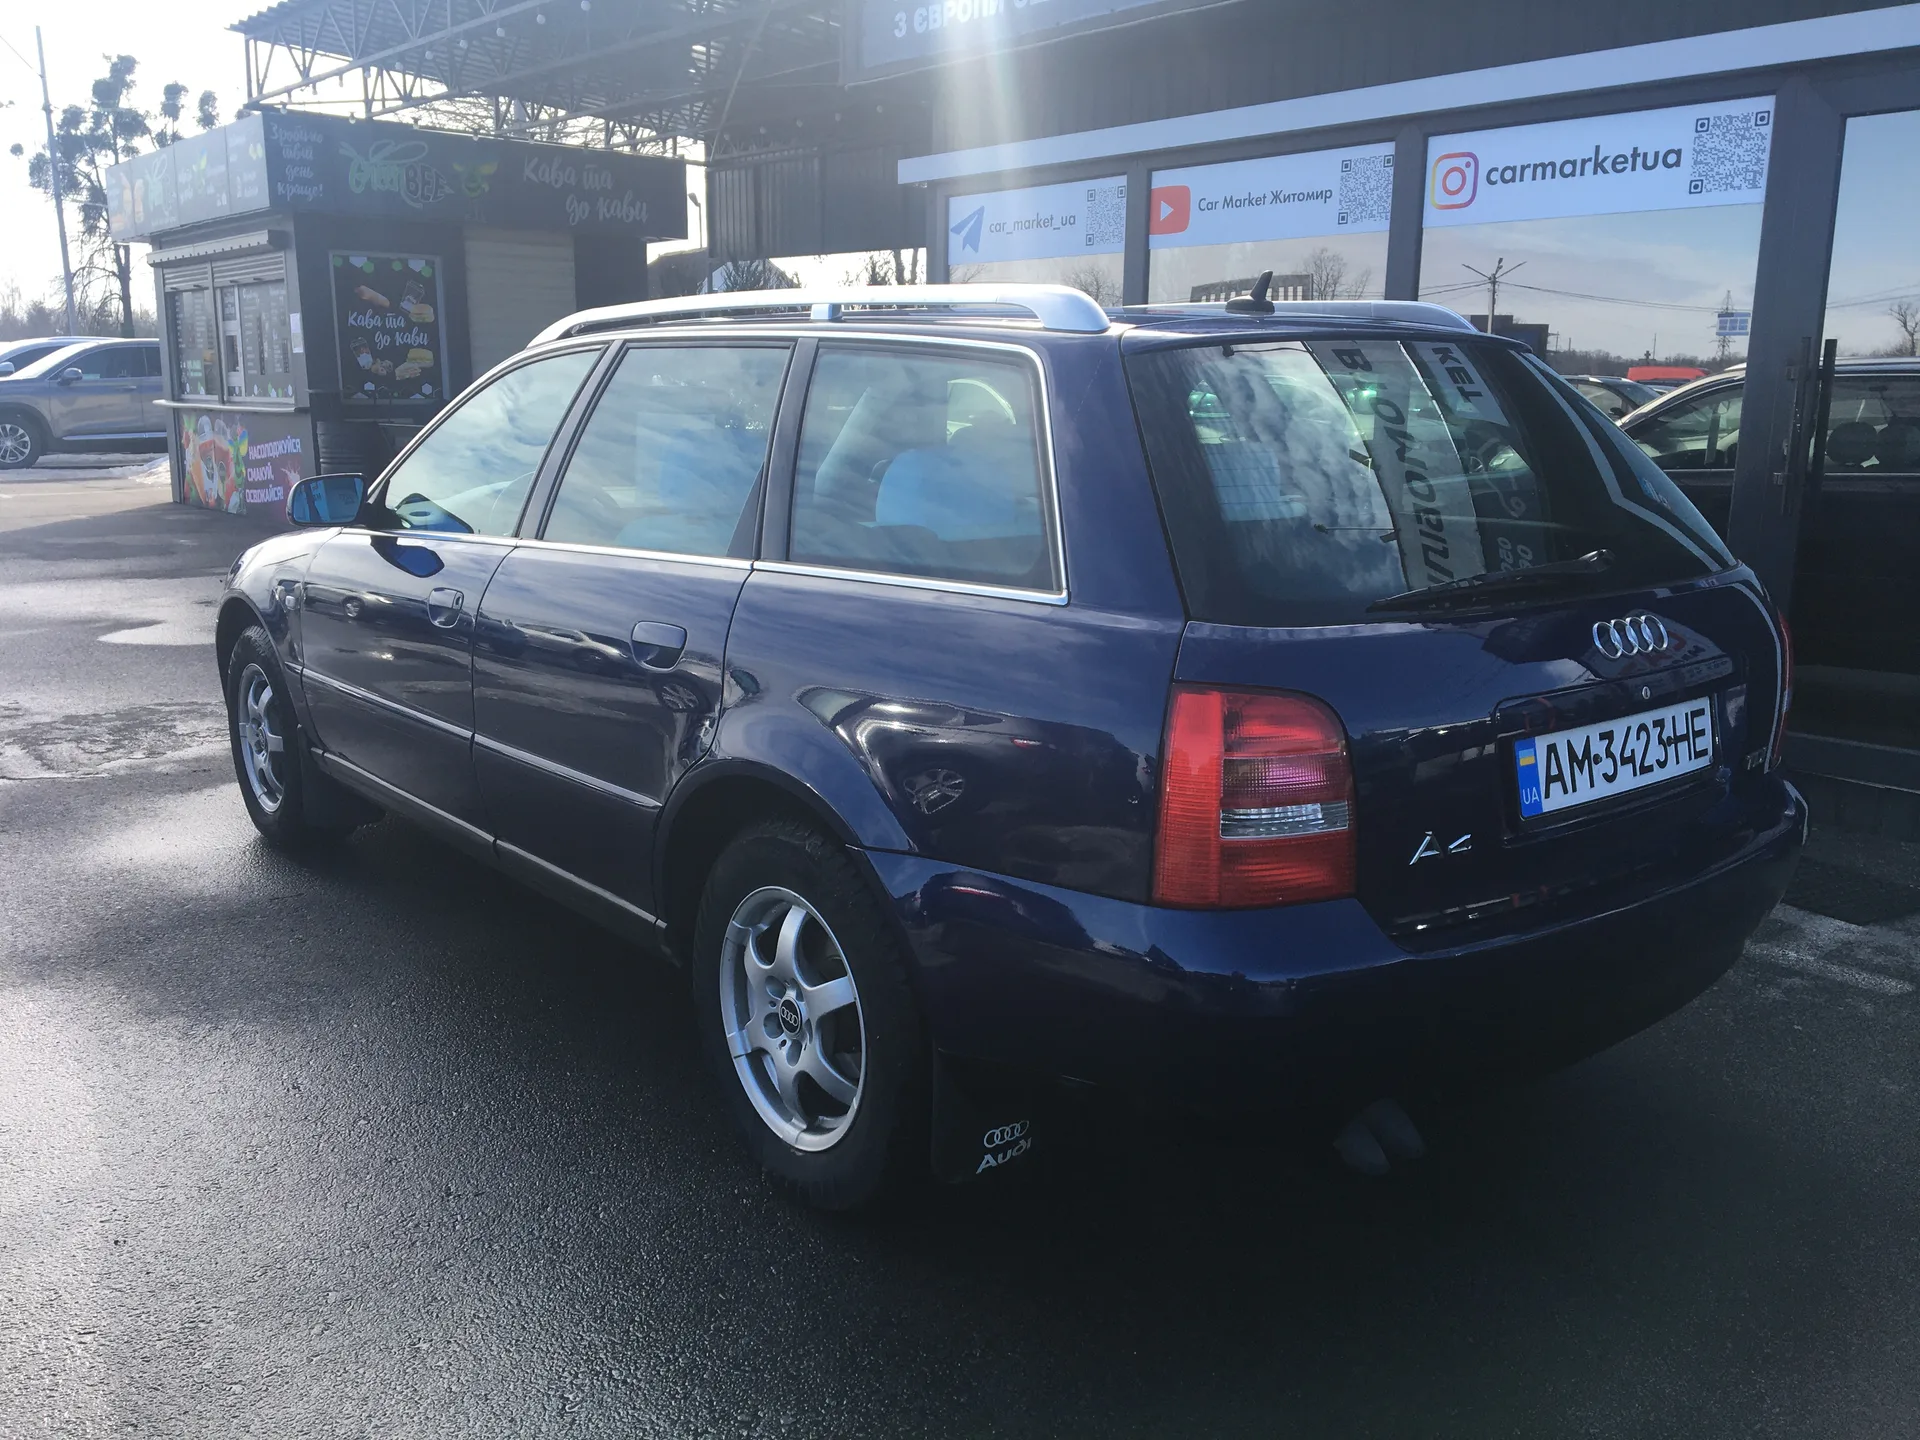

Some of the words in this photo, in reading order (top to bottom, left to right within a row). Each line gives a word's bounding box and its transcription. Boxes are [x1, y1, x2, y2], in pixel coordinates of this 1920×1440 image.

[893, 11, 907, 37] З
[913, 0, 1004, 33] ЄВРОПИ
[523, 155, 576, 188] Кава
[583, 163, 613, 190] та
[1485, 145, 1682, 186] carmarketua
[565, 194, 590, 226] до
[597, 189, 648, 223] кави
[1198, 197, 1220, 212] Car
[1222, 191, 1267, 210] Market
[1270, 187, 1333, 205] Житомир
[989, 212, 1076, 235] car_market_ua
[348, 308, 382, 329] Кава
[385, 312, 406, 328] та
[374, 331, 391, 349] до
[395, 326, 428, 346] кави
[1598, 718, 1669, 784] 3423
[1523, 788, 1540, 805] UA
[976, 1137, 1032, 1174] Audi
